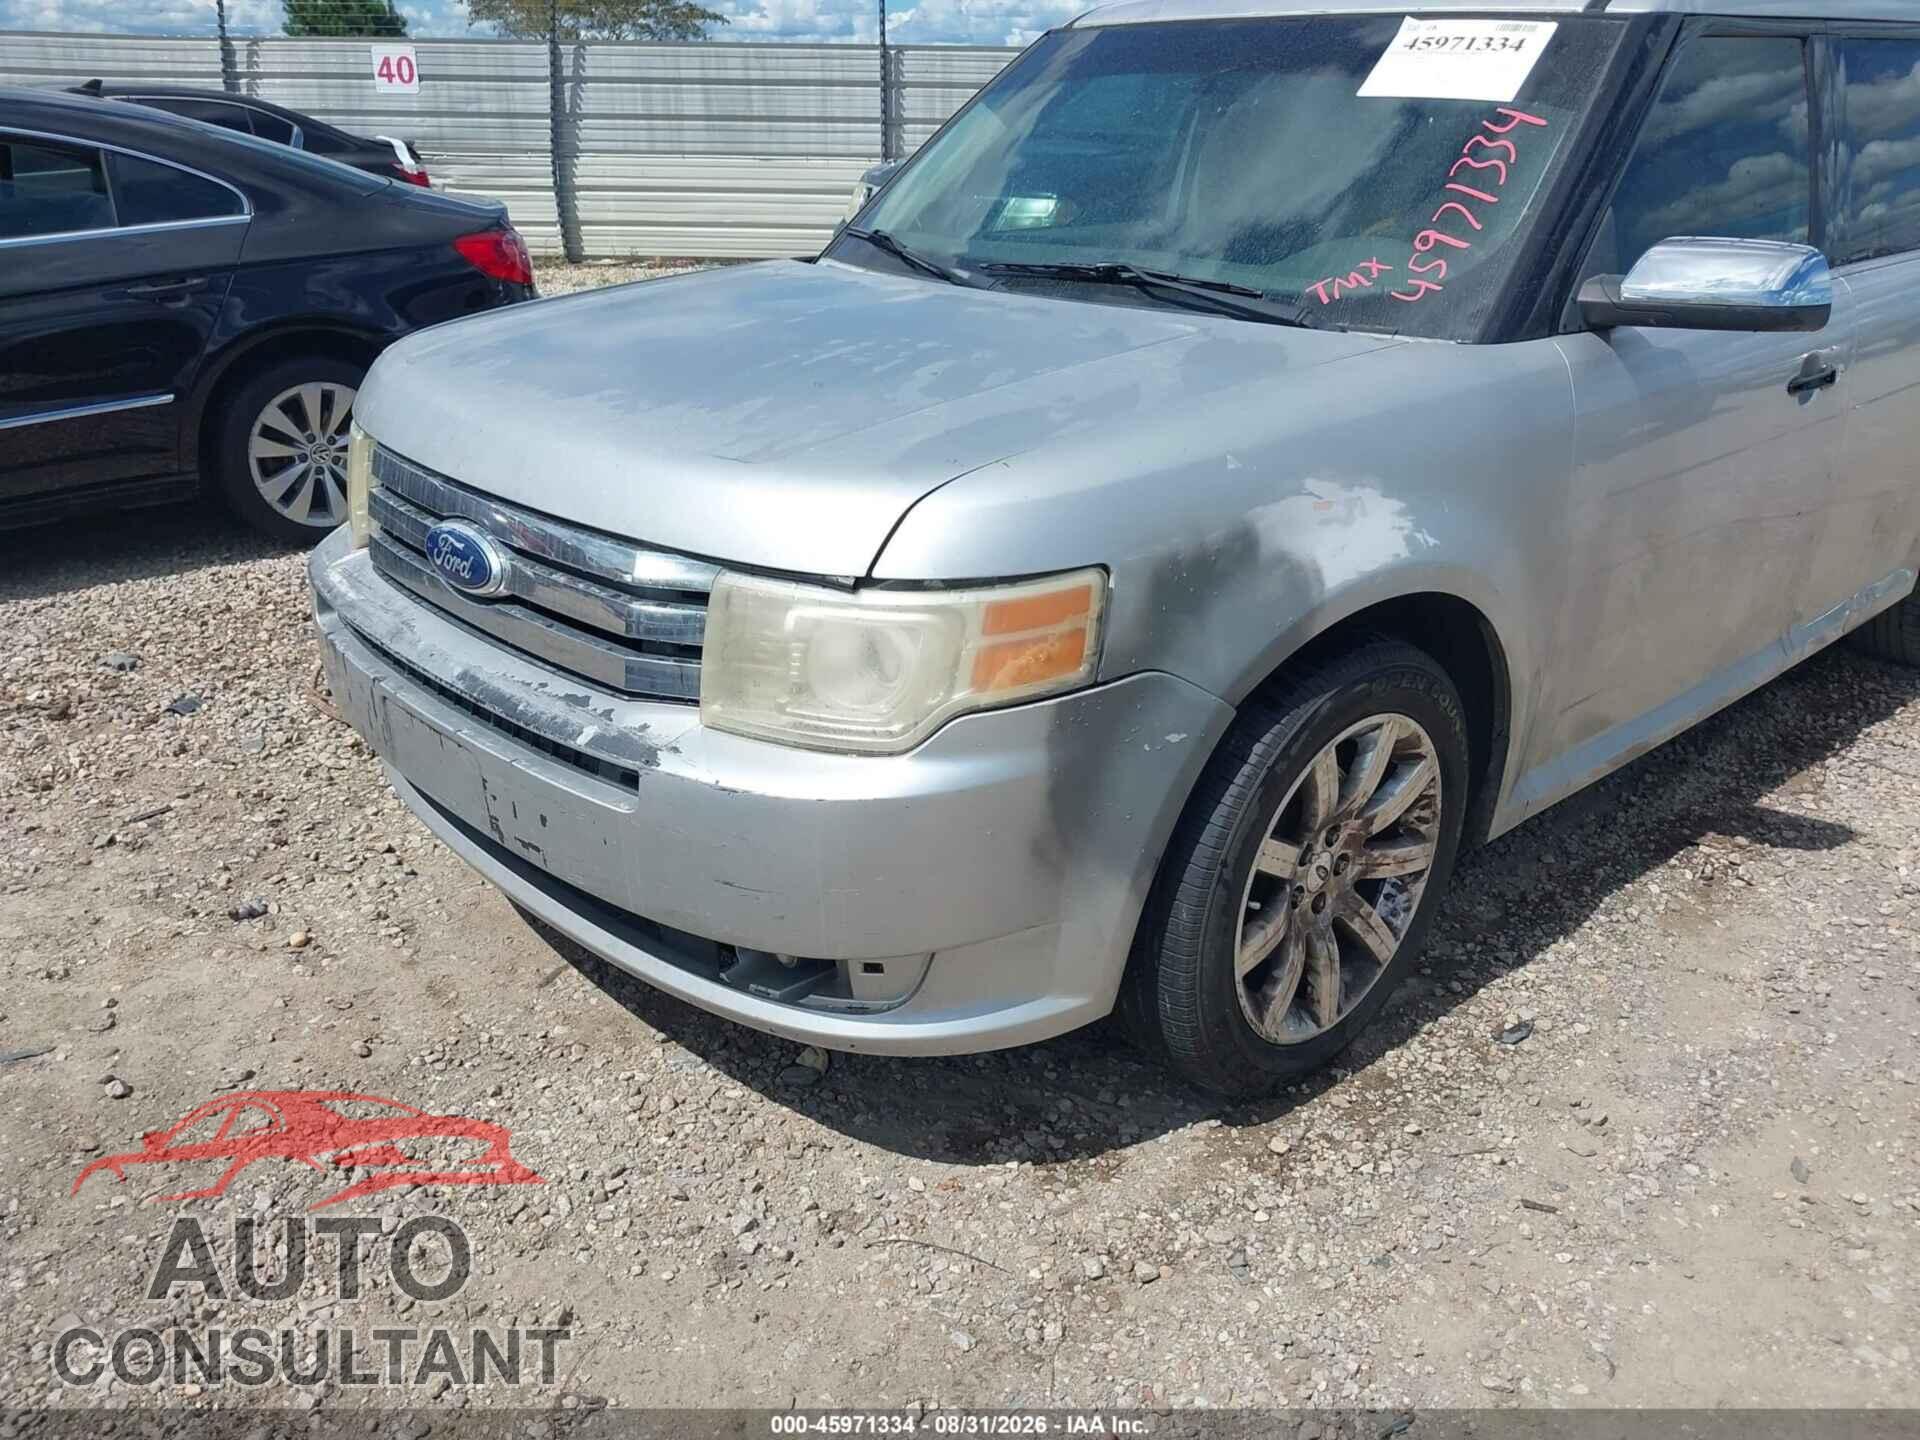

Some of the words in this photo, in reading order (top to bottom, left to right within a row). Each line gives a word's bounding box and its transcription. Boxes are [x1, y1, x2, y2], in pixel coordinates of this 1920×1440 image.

[1403, 36, 1526, 52] 45971334
[377, 55, 415, 84] 40
[1390, 107, 1548, 302] 45971334
[433, 533, 476, 579] Ford
